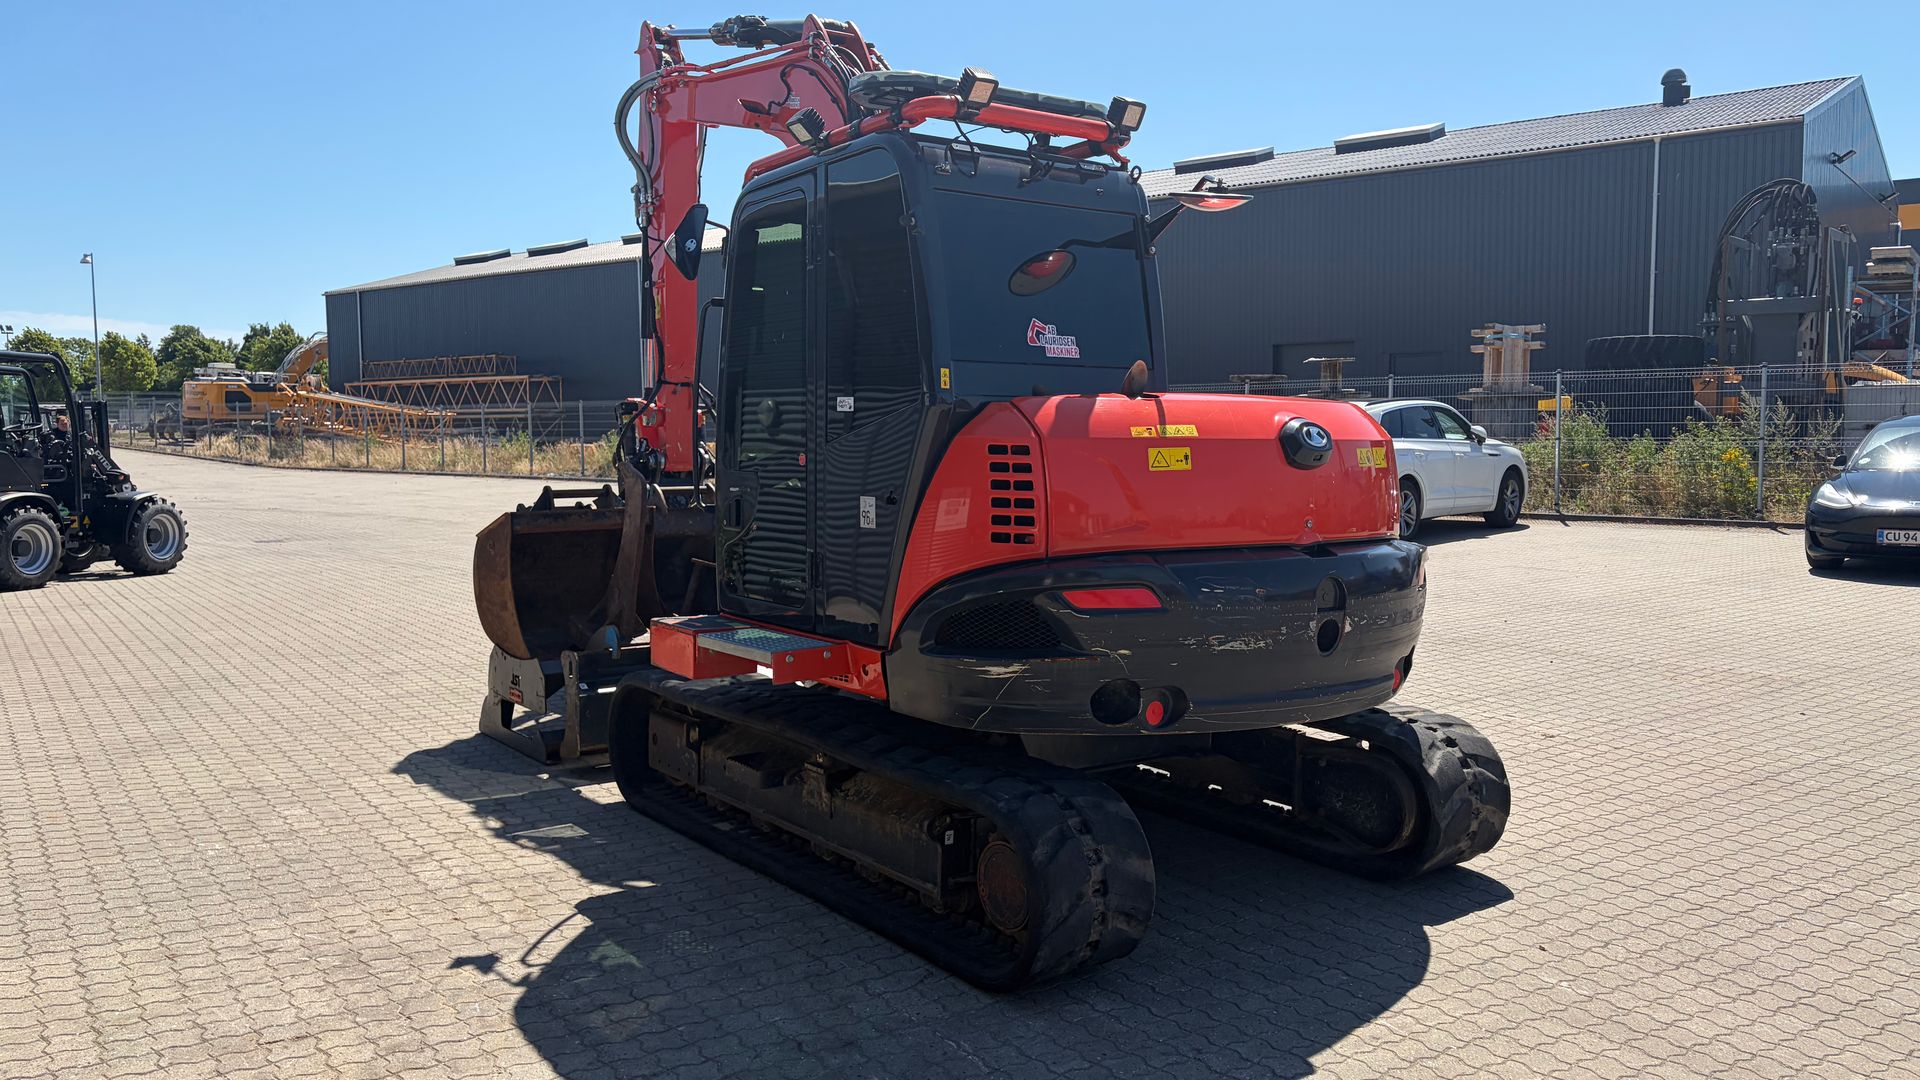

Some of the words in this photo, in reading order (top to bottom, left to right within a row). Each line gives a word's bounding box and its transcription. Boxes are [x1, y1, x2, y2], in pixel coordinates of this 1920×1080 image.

[1047, 325, 1056, 336] AB
[1040, 335, 1076, 347] LAURIDSEN
[1046, 346, 1080, 358] MASKINER
[1885, 531, 1901, 542] CU
[1903, 531, 1918, 543] 94
